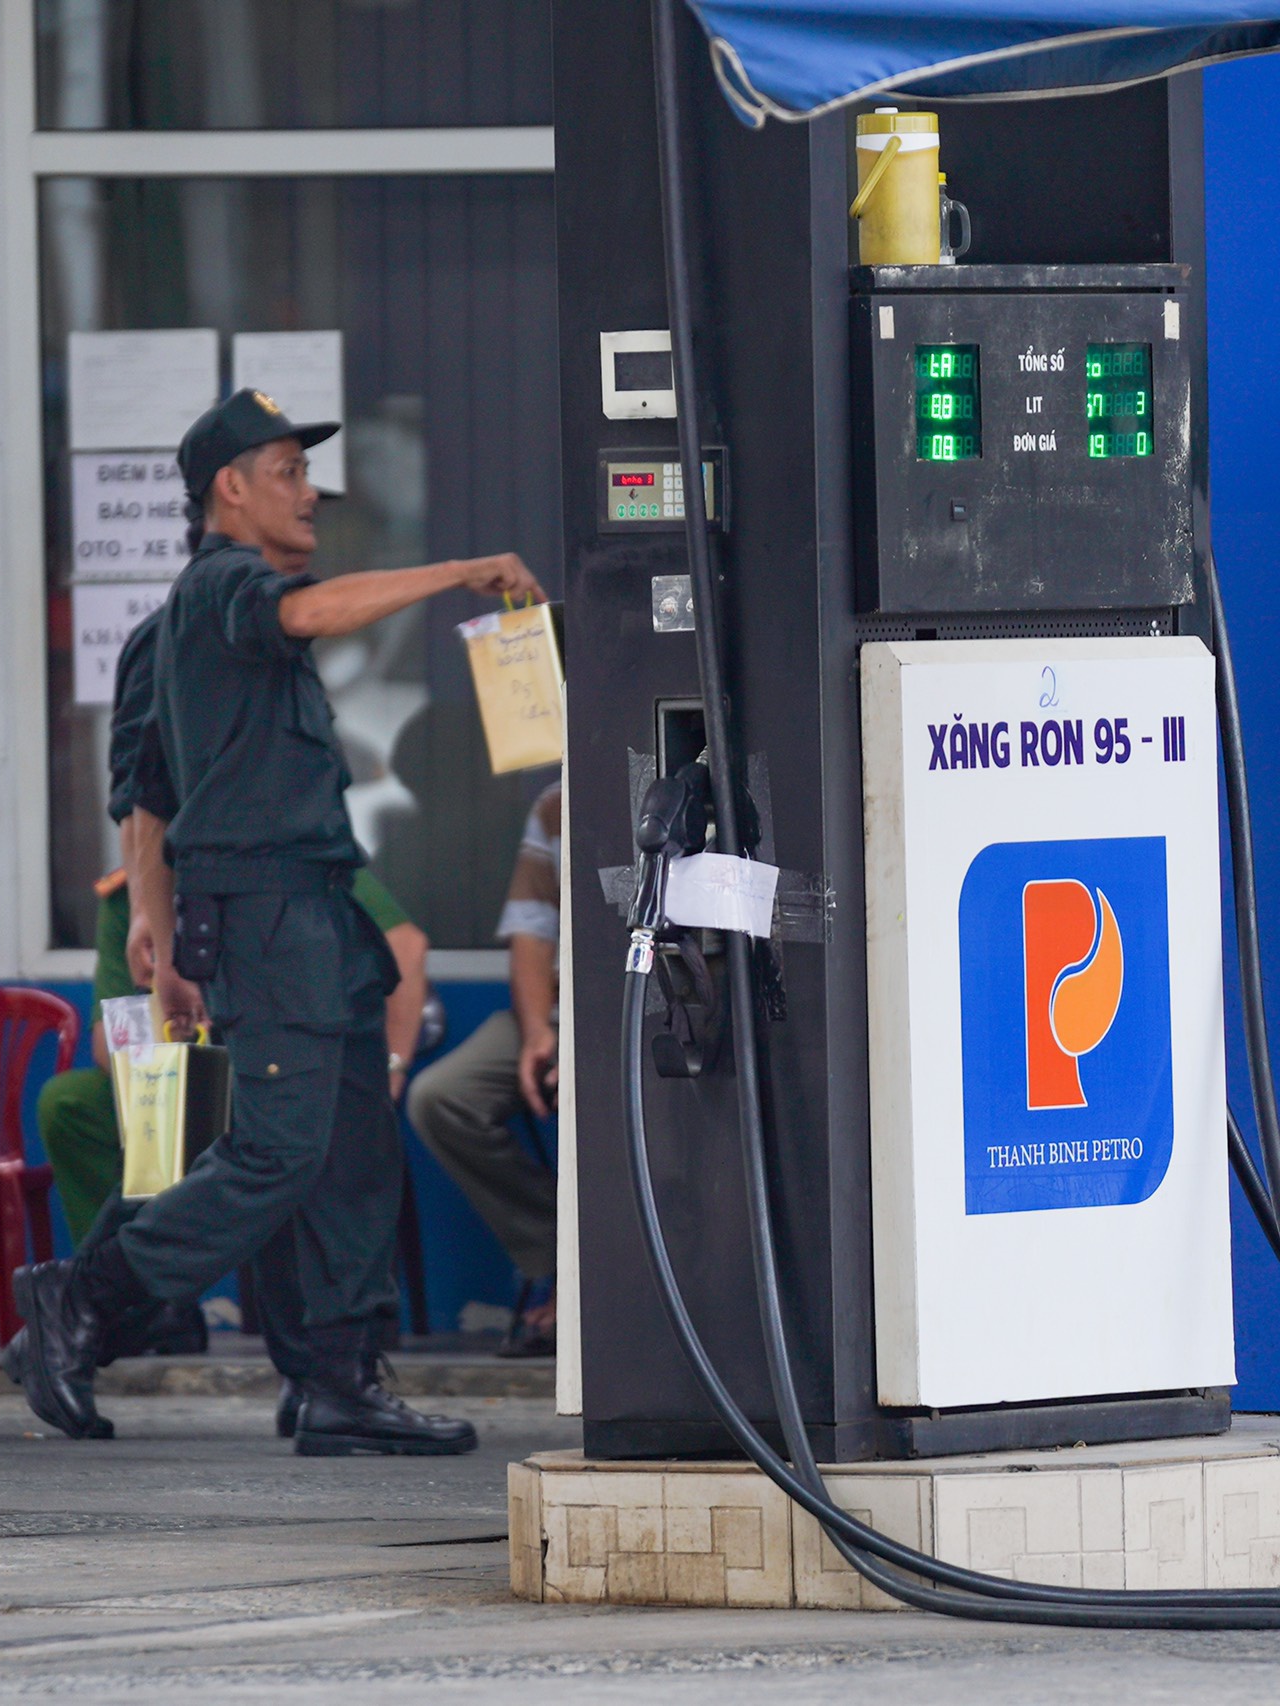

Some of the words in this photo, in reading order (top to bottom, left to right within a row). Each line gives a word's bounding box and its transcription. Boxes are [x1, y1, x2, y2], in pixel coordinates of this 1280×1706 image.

[1018, 345, 1048, 372] TỔNG
[1050, 347, 1065, 372] SỐ
[1026, 396, 1043, 414] LIT
[1013, 432, 1036, 452] ĐƠN
[1039, 429, 1057, 452] GIÁ
[1039, 666, 1060, 708] 2
[927, 713, 1010, 770] XĂNG
[1020, 719, 1084, 767] RON
[1094, 717, 1131, 764] 95
[1162, 716, 1186, 762] III
[987, 1143, 1046, 1169] THANH
[1049, 1140, 1088, 1165] BINH
[1092, 1137, 1143, 1162] PETRO
